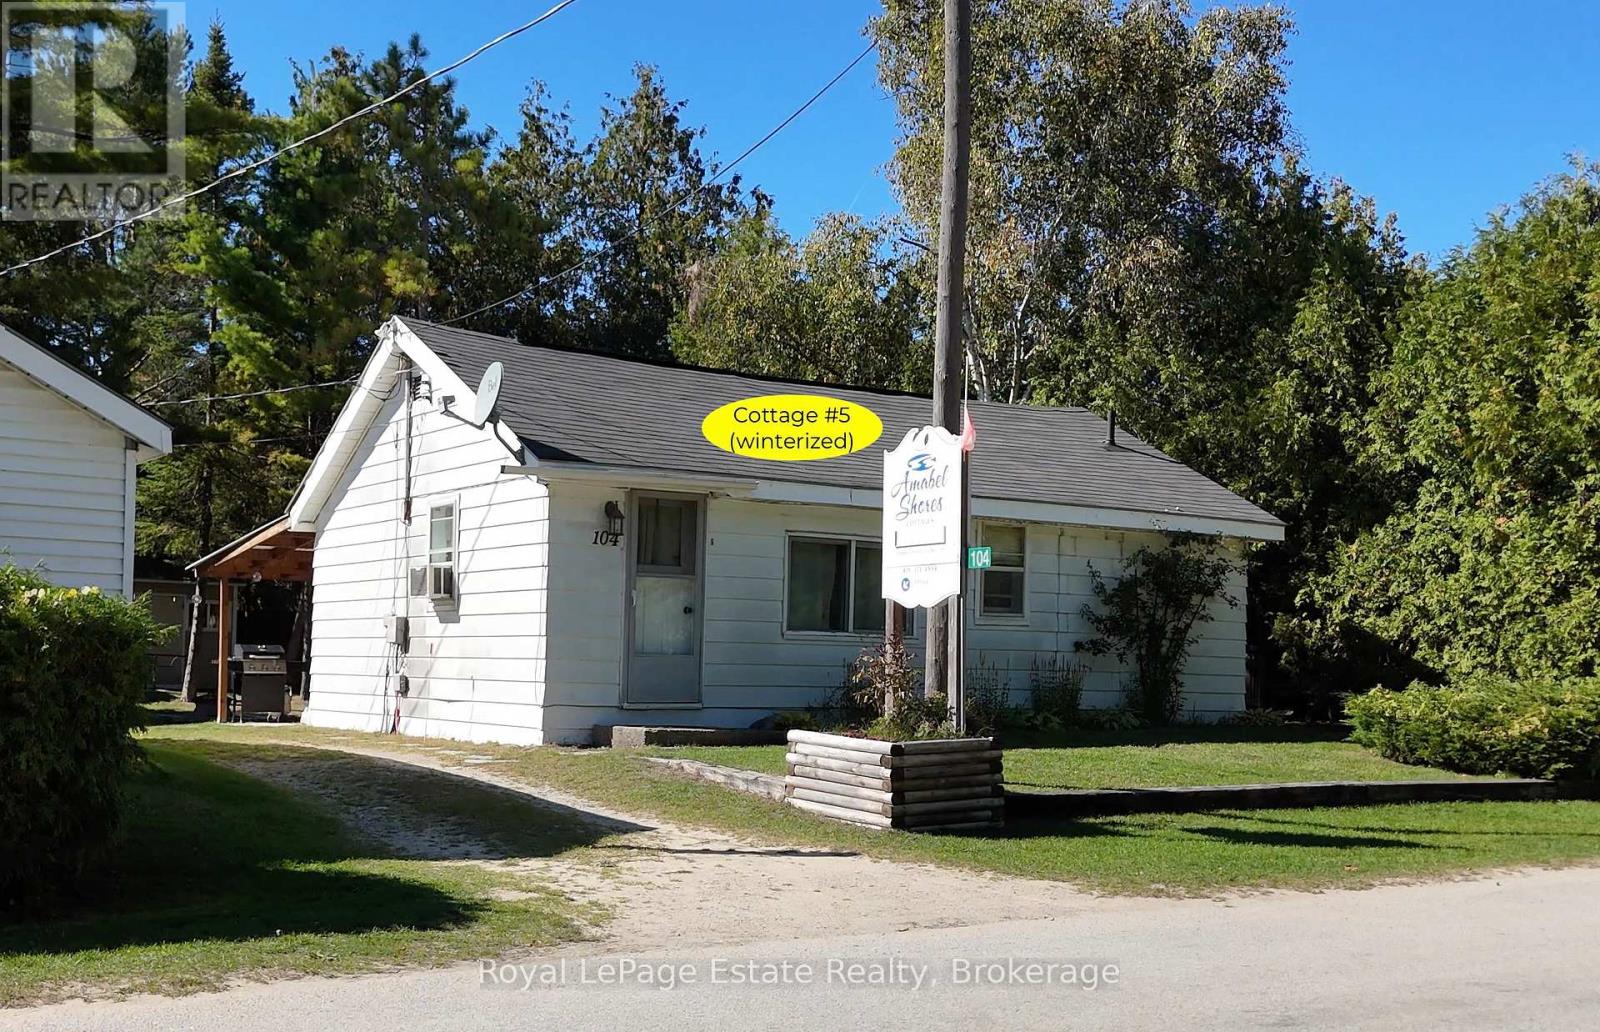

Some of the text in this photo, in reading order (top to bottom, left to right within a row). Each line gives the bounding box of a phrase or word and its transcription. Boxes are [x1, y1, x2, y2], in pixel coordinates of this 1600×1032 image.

[891, 464, 949, 498] Amabel
[896, 494, 943, 521] Shores
[592, 530, 620, 546] 104
[970, 550, 989, 567] 104
